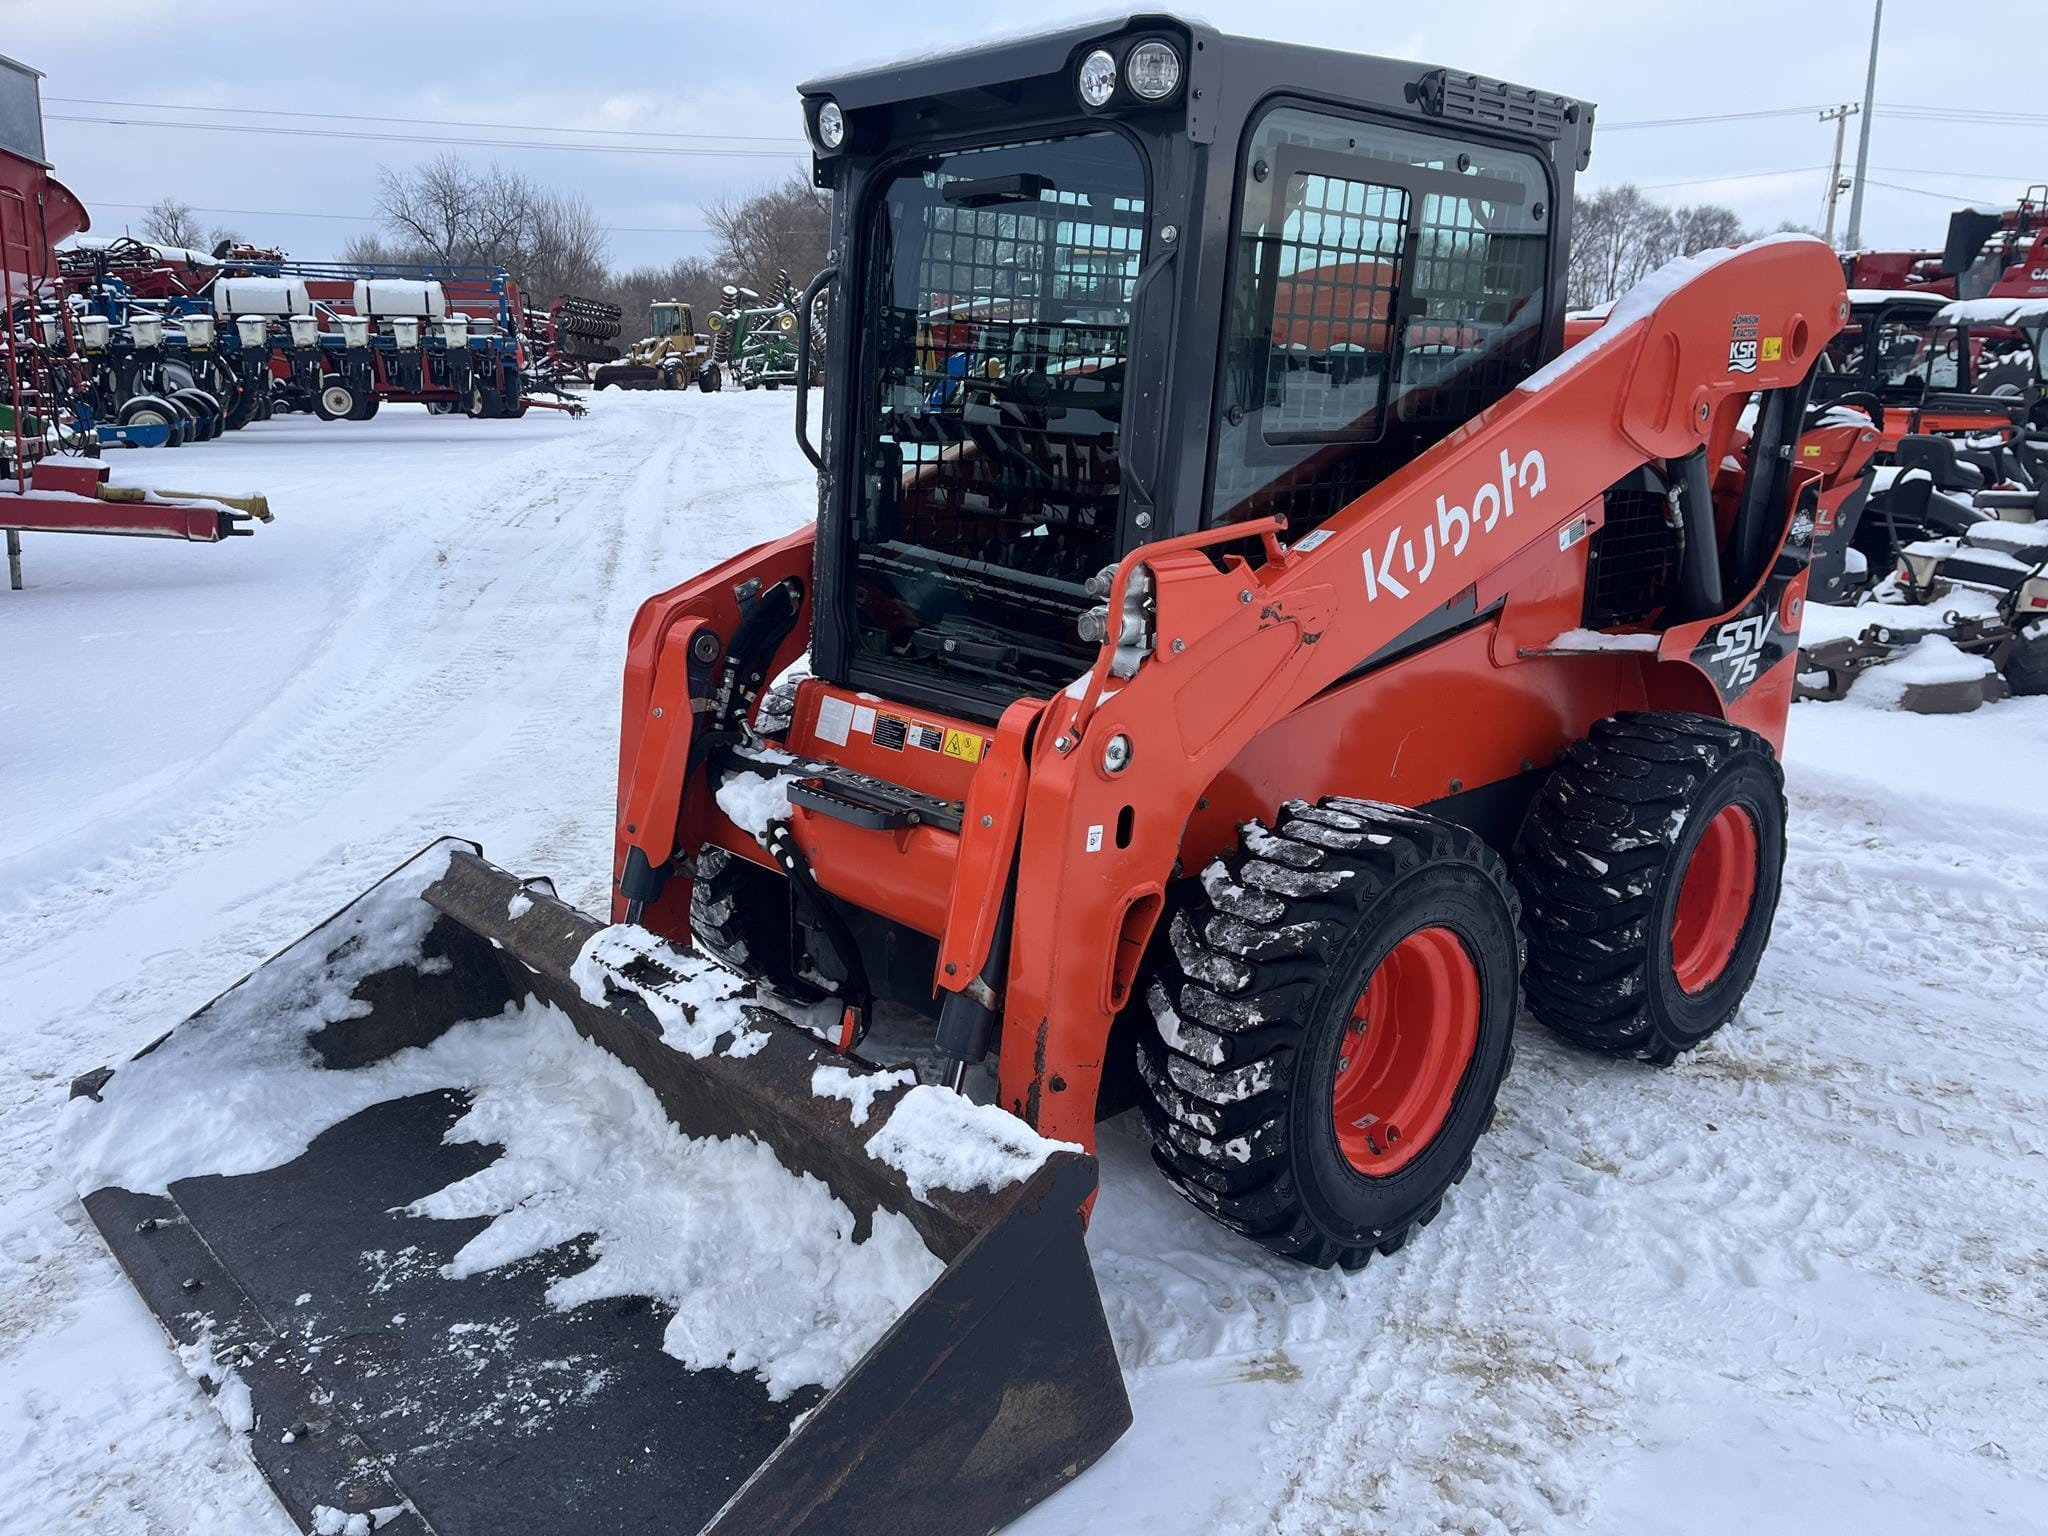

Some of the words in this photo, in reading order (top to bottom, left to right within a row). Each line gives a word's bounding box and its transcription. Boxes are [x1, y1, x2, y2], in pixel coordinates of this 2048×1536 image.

[1732, 313, 1760, 325] JOHNSON
[1732, 326, 1759, 338] TRACTOR
[1730, 340, 1757, 359] KSR
[1361, 448, 1547, 602] Kubota
[1710, 611, 1778, 663] SSV
[1726, 651, 1760, 689] 75
